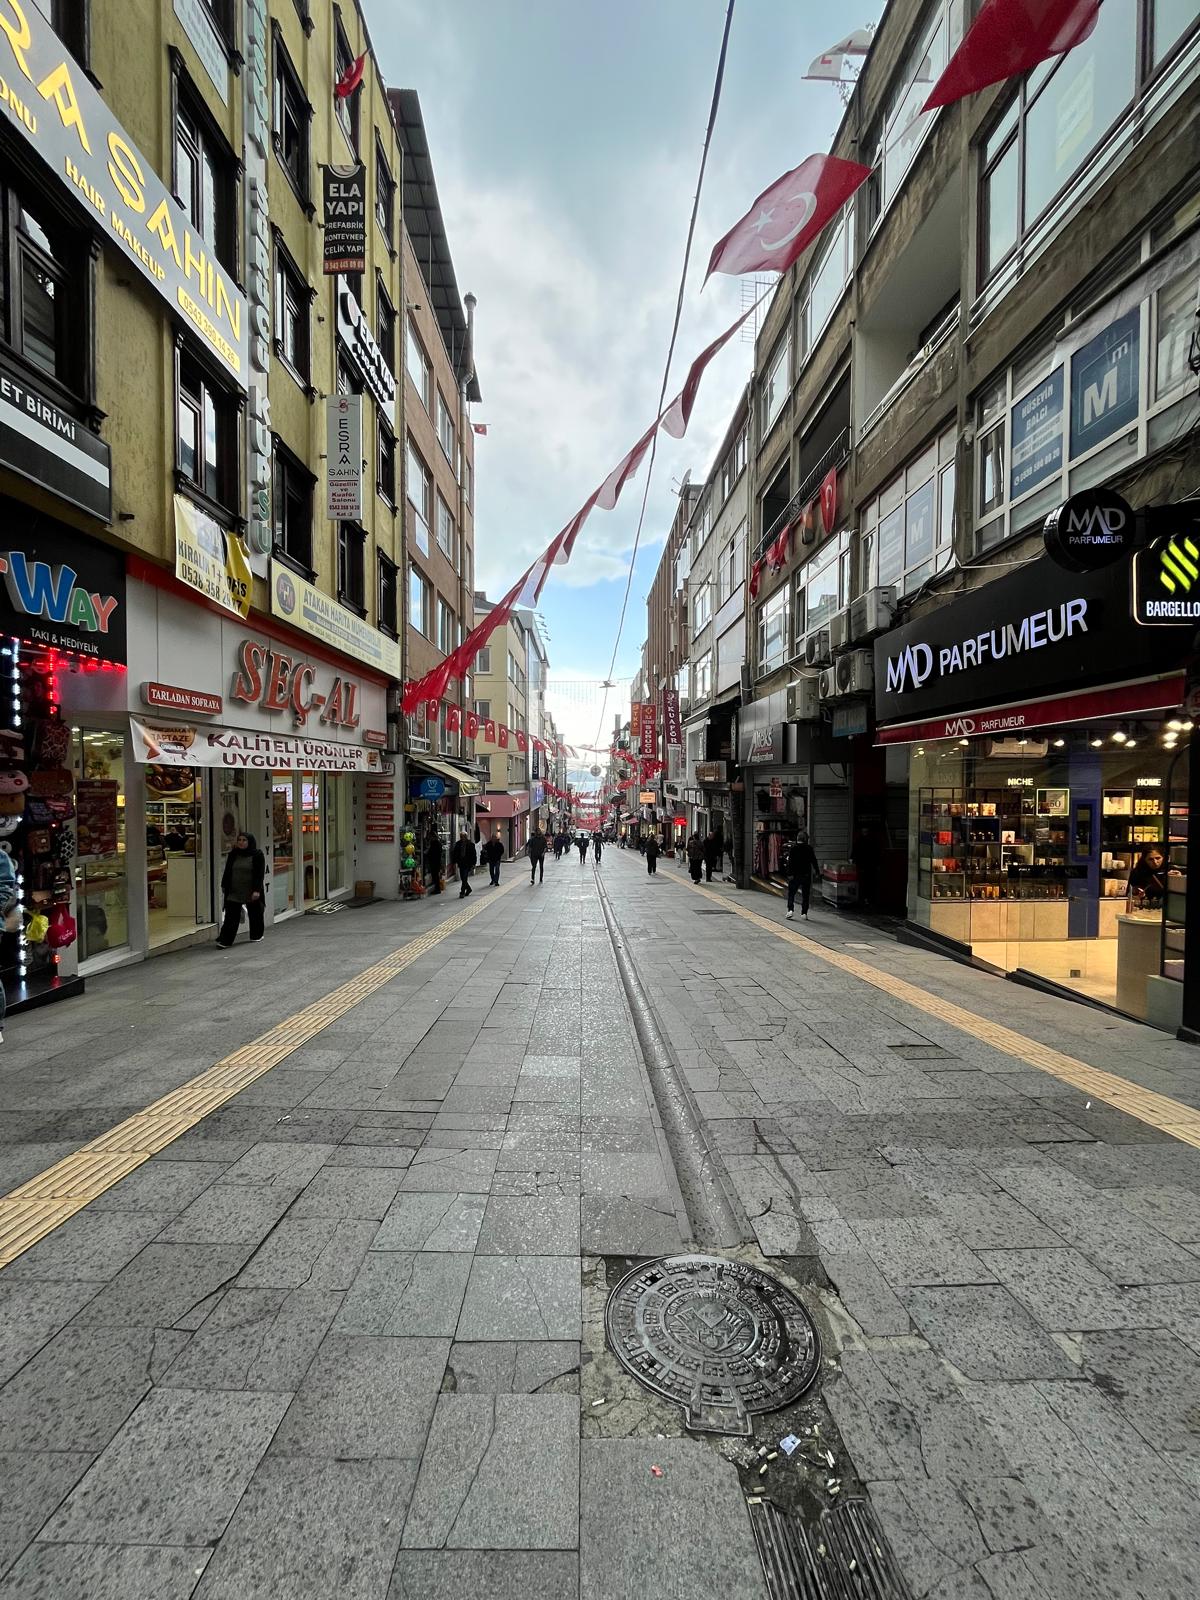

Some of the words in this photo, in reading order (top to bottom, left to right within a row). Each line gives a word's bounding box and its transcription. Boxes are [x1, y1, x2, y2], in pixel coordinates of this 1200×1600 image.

[329, 183, 361, 198] ELA
[326, 202, 364, 216] YAPI
[65, 157, 106, 217] HAIR
[111, 210, 165, 284] MAKEUP
[324, 221, 364, 230] PREFABRİK
[325, 233, 364, 243] KONTEYNER
[324, 245, 345, 255] ÇELİK
[346, 245, 364, 253] YAPI
[1083, 366, 1118, 426] M
[26, 394, 75, 440] BİRİMİ
[338, 418, 351, 465] ESRA
[256, 386, 272, 555] KURSU
[1066, 505, 1126, 535] MAD
[1069, 535, 1123, 544] PARFUMEUR
[1146, 601, 1200, 617] BARGELLO
[30, 628, 49, 642] TAKI
[51, 633, 58, 643] &
[60, 636, 99, 655] HEDİYELİK
[885, 643, 933, 694] MAD
[939, 598, 1089, 677] PARFUMEUR
[233, 641, 360, 728] SEÇ-AL
[151, 688, 190, 704] TARLADAN
[191, 694, 220, 710] SOFRAYA
[945, 718, 976, 736] MAD
[981, 715, 1025, 731] PARFUMEUR
[207, 733, 299, 755] KALİTELİ
[304, 740, 363, 760] ÜRÜNLER
[222, 752, 291, 768] UYGUN
[296, 754, 357, 770] FİYATLAR
[1007, 777, 1034, 786] NICHE
[1137, 778, 1162, 786] HOME
